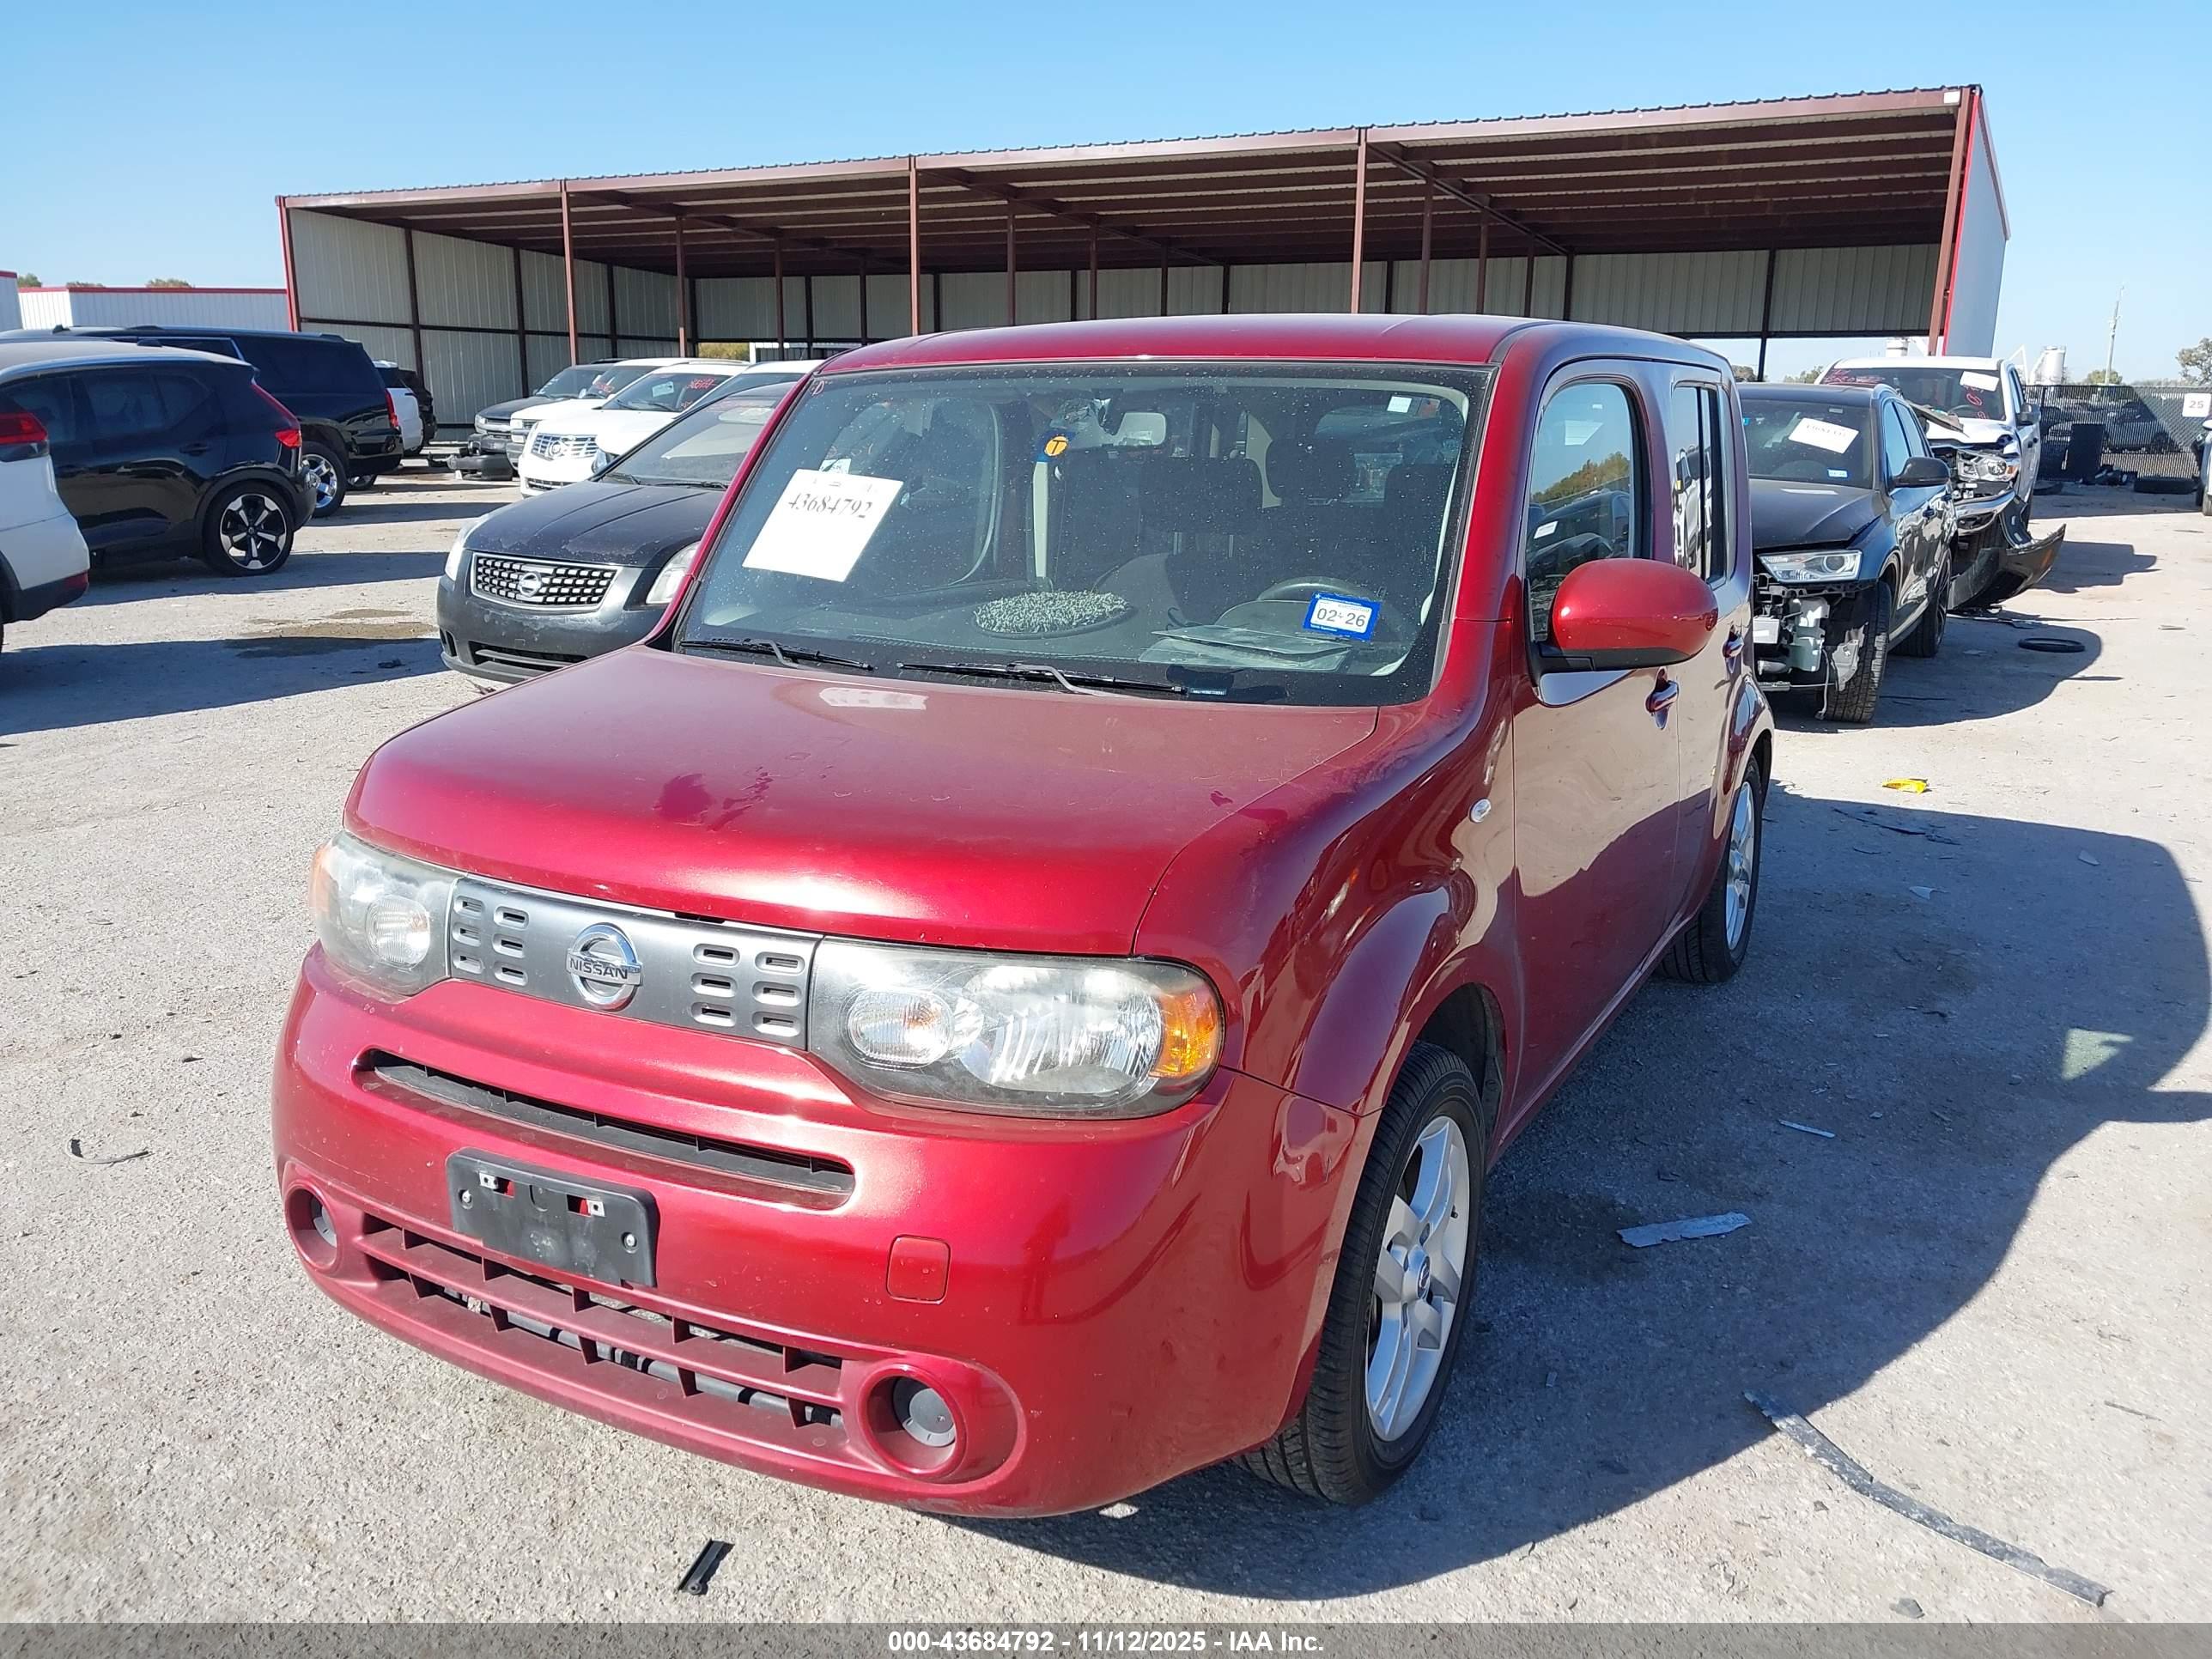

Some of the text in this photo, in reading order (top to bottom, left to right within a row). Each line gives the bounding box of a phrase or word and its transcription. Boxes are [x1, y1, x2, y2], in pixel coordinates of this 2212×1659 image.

[2189, 400, 2204, 409] 25
[1052, 439, 1066, 454] T
[788, 493, 872, 519] 43684792
[1317, 608, 1337, 622] 02
[1345, 612, 1366, 627] 26
[569, 957, 628, 979] NISSAN
